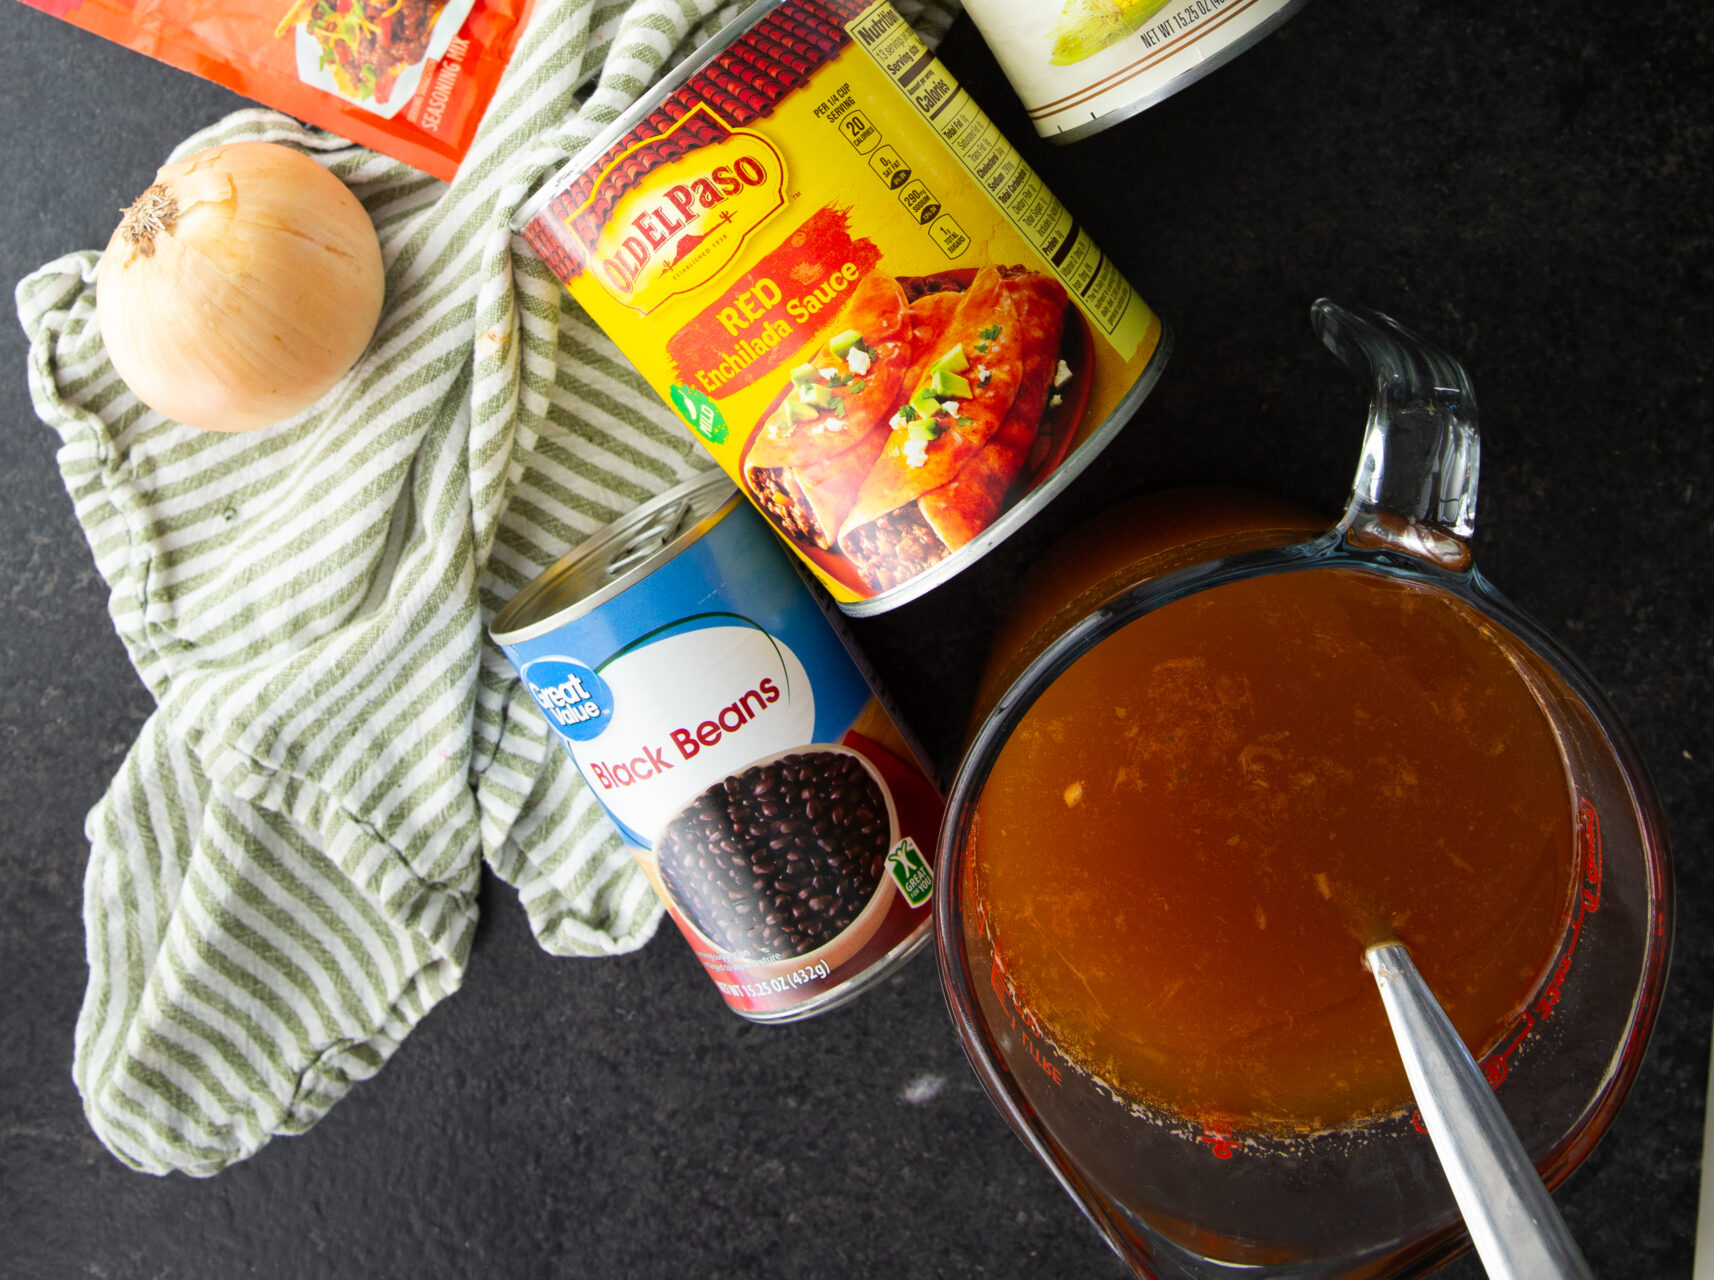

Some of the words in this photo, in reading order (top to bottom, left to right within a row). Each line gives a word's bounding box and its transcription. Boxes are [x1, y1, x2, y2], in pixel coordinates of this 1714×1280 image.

[857, 9, 900, 46] Nutrition
[1140, 27, 1161, 49] NET
[1157, 19, 1175, 39] WT
[1172, 5, 1200, 29] 15.25
[886, 51, 914, 75] Serving
[421, 61, 460, 132] SEASONING
[446, 35, 470, 62] MIX
[915, 79, 950, 113] Calories
[813, 102, 829, 119] PER
[827, 93, 839, 109] 1/4
[836, 83, 851, 99] CUP
[826, 96, 856, 124] SERVING
[846, 116, 865, 137] 20
[853, 126, 875, 147] CALORIES
[943, 125, 958, 140] Total
[953, 119, 964, 130] Fat
[883, 167, 893, 178] SAT
[891, 160, 901, 171] FAT
[976, 152, 1000, 179] Cholesterol
[912, 194, 931, 213] SODIUM
[602, 236, 650, 293] OLD
[631, 206, 685, 253] EL
[944, 232, 959, 246] TOTAL
[947, 236, 965, 254] SUGARS
[672, 248, 711, 280] ESTABLISHED
[712, 233, 728, 249] 1938
[716, 278, 782, 336] RED
[695, 318, 793, 393] Enchilada
[786, 262, 860, 324] Sauce
[699, 404, 715, 438] MILD
[529, 673, 592, 709] Great
[550, 701, 602, 726] Value
[590, 745, 674, 790] Black
[670, 677, 780, 760] Beans
[905, 866, 927, 892] GREAT
[918, 875, 932, 893] YOU
[729, 984, 745, 998] WT
[742, 982, 773, 998] 15.25
[770, 976, 790, 993] OZ
[786, 958, 831, 989] (432g)
